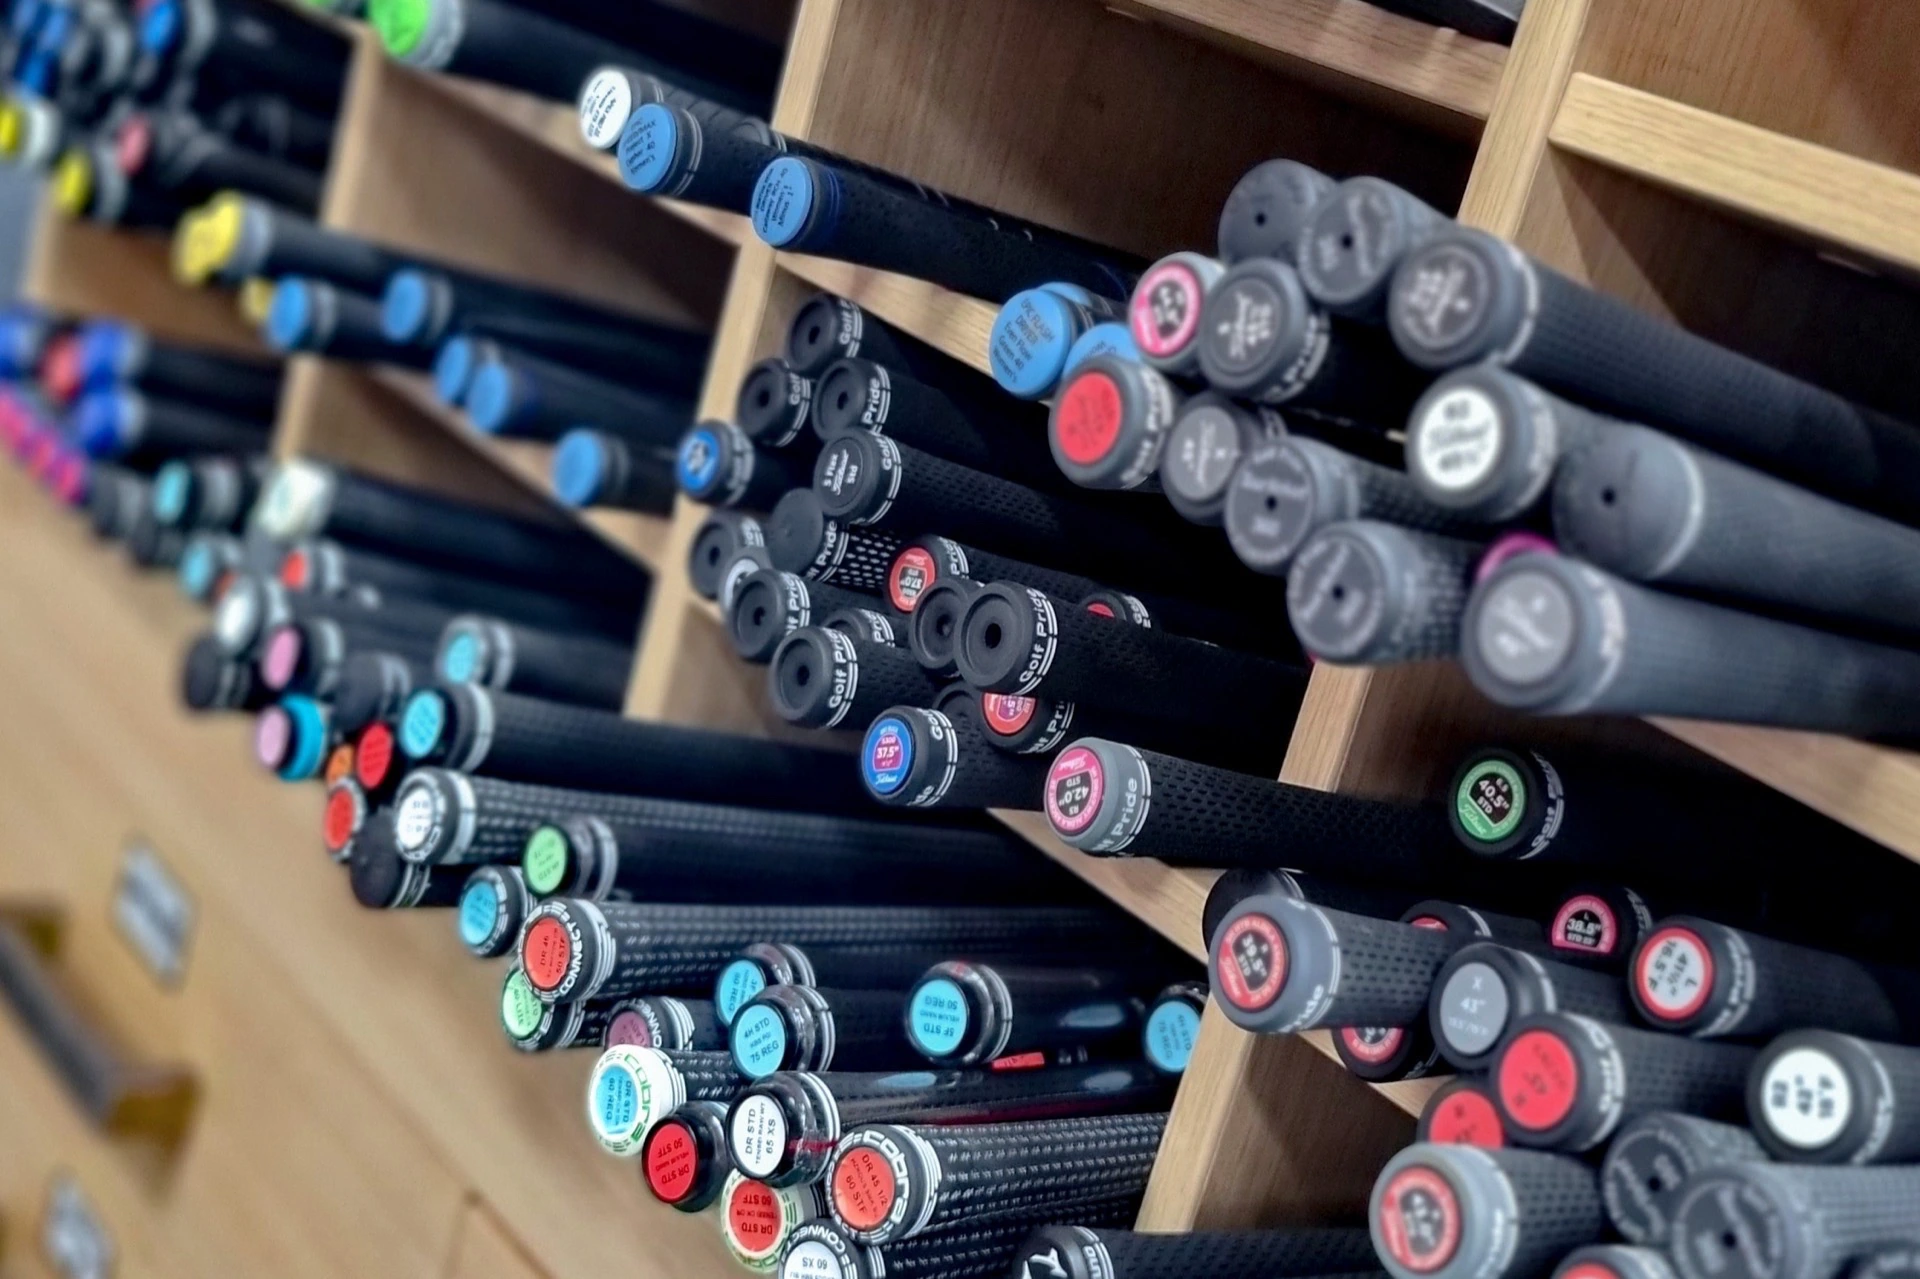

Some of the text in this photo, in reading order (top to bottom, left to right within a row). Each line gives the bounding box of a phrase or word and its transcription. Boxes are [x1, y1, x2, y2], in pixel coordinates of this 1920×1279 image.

[1032, 314, 1055, 342] FLASH
[861, 377, 880, 425] Pride
[816, 520, 838, 567] Pride
[1019, 645, 1046, 683] Golf
[828, 667, 848, 709] Golf
[1058, 786, 1090, 806] 42.0"
[1111, 777, 1139, 836] Pride
[1477, 796, 1493, 814] STD
[1479, 780, 1511, 810] 40.5"
[1567, 918, 1602, 934] 38.5"
[559, 921, 583, 995] CONNECT
[925, 995, 945, 1008] REG
[744, 1017, 770, 1039] 4H STD
[923, 1023, 942, 1034] STD
[750, 1040, 779, 1063] 75 REG
[606, 1094, 614, 1121] REG
[622, 1080, 632, 1123] DR STD
[745, 1108, 756, 1154] DR STD
[766, 1119, 776, 1154] 65 XS
[658, 1138, 683, 1158] 50 STF
[661, 1164, 690, 1184] DR STD
[862, 1154, 888, 1207] DR 45 1/2
[742, 1194, 772, 1205] 60 STF
[846, 1175, 867, 1213] 60 STF
[742, 1221, 773, 1235] DR STD
[786, 1224, 847, 1256] CONNECT
[802, 1256, 828, 1270] 60 XS
